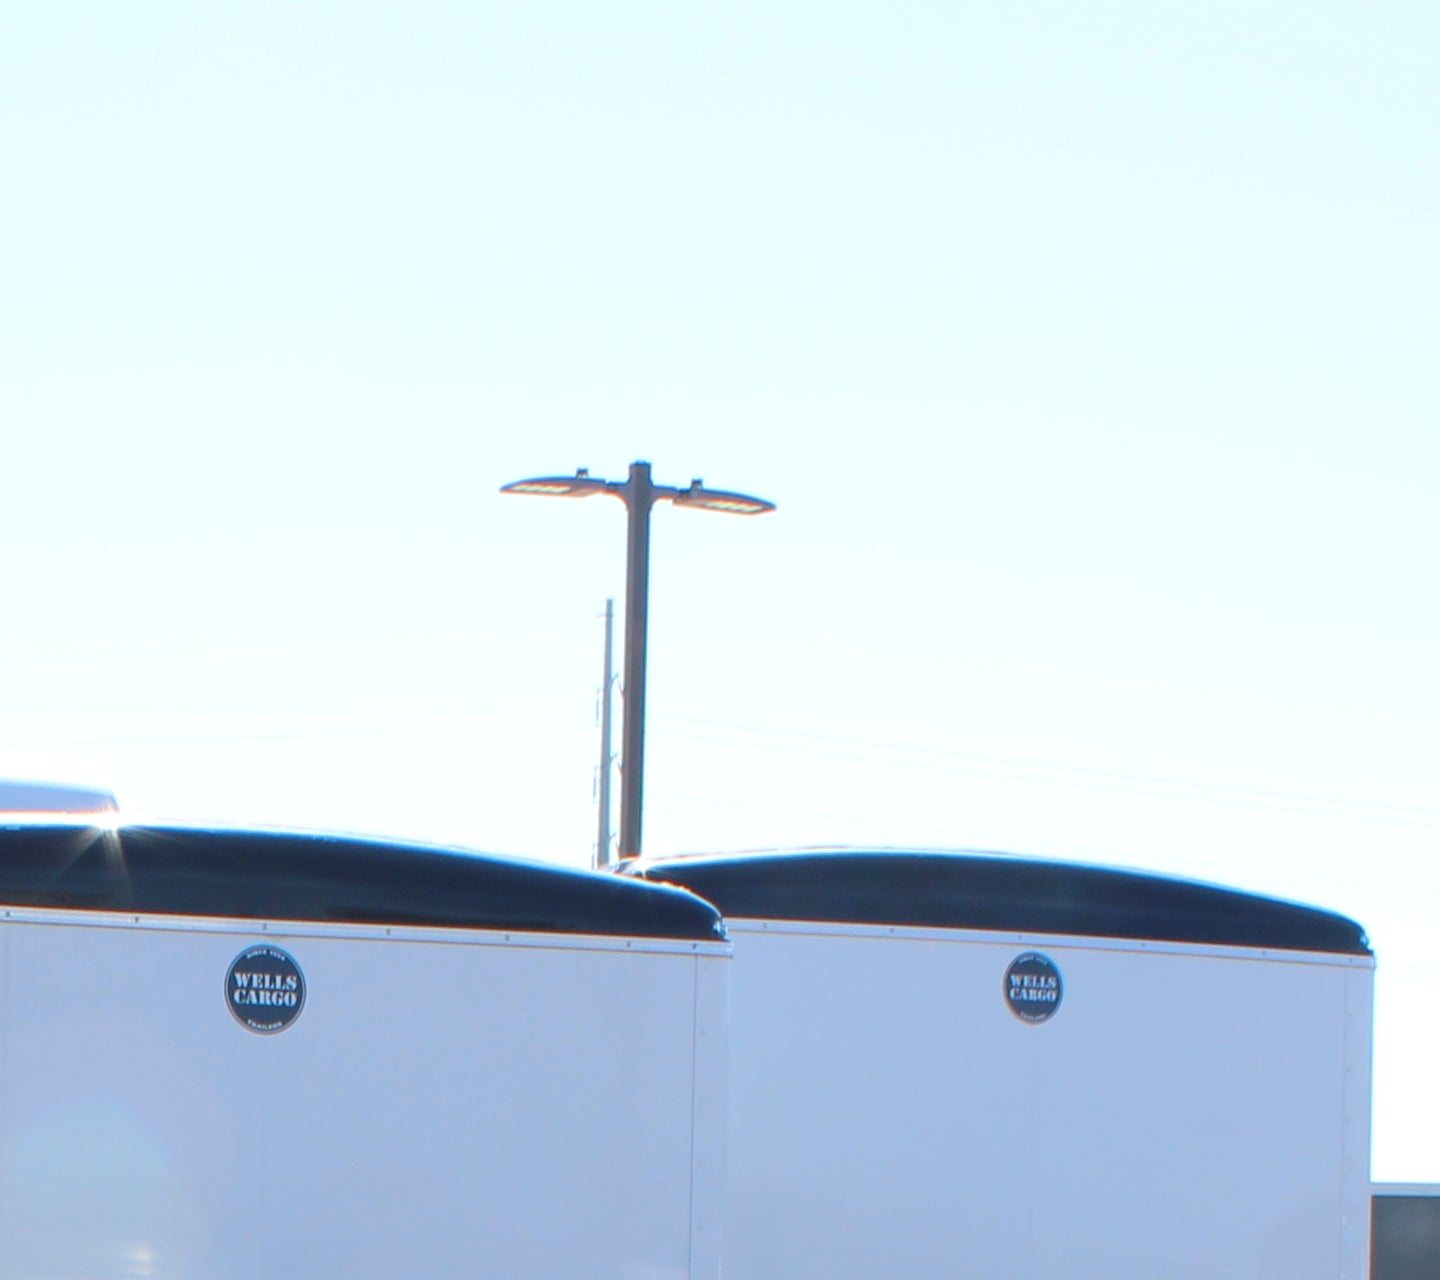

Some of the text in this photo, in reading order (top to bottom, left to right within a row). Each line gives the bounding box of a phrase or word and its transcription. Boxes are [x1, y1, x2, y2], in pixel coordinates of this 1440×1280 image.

[234, 972, 297, 991] WELLS
[1010, 974, 1057, 989] WELLS
[233, 988, 297, 1007] CARGO
[1009, 988, 1057, 1002] CARGO
